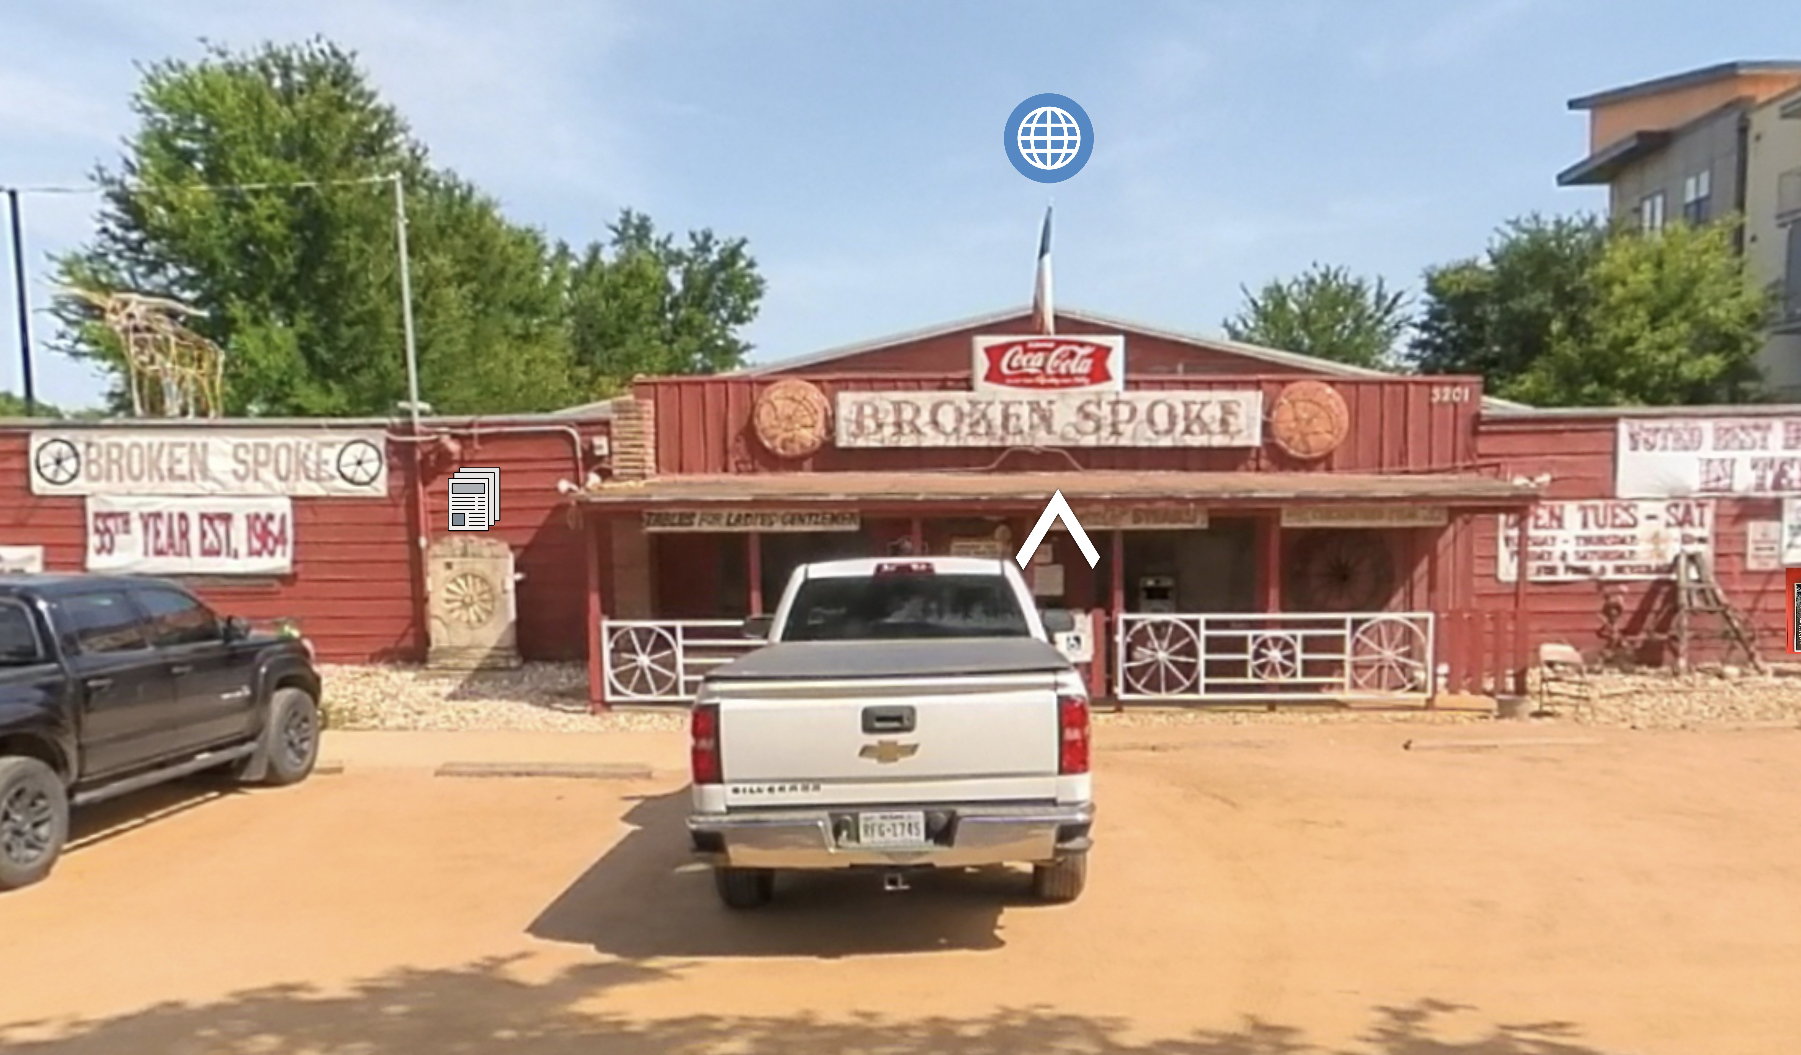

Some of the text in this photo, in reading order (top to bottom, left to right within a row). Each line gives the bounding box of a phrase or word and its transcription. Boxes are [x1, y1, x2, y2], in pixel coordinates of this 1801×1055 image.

[853, 400, 1242, 437] BROKEN SPOKE
[1713, 422, 1771, 451] BEST
[85, 441, 337, 482] BROKEN SPOKE
[1699, 458, 1736, 492] IN
[1578, 504, 1638, 529] TUES
[1665, 503, 1708, 528] SAT
[140, 512, 191, 557] YEAR
[246, 512, 287, 557] 1964
